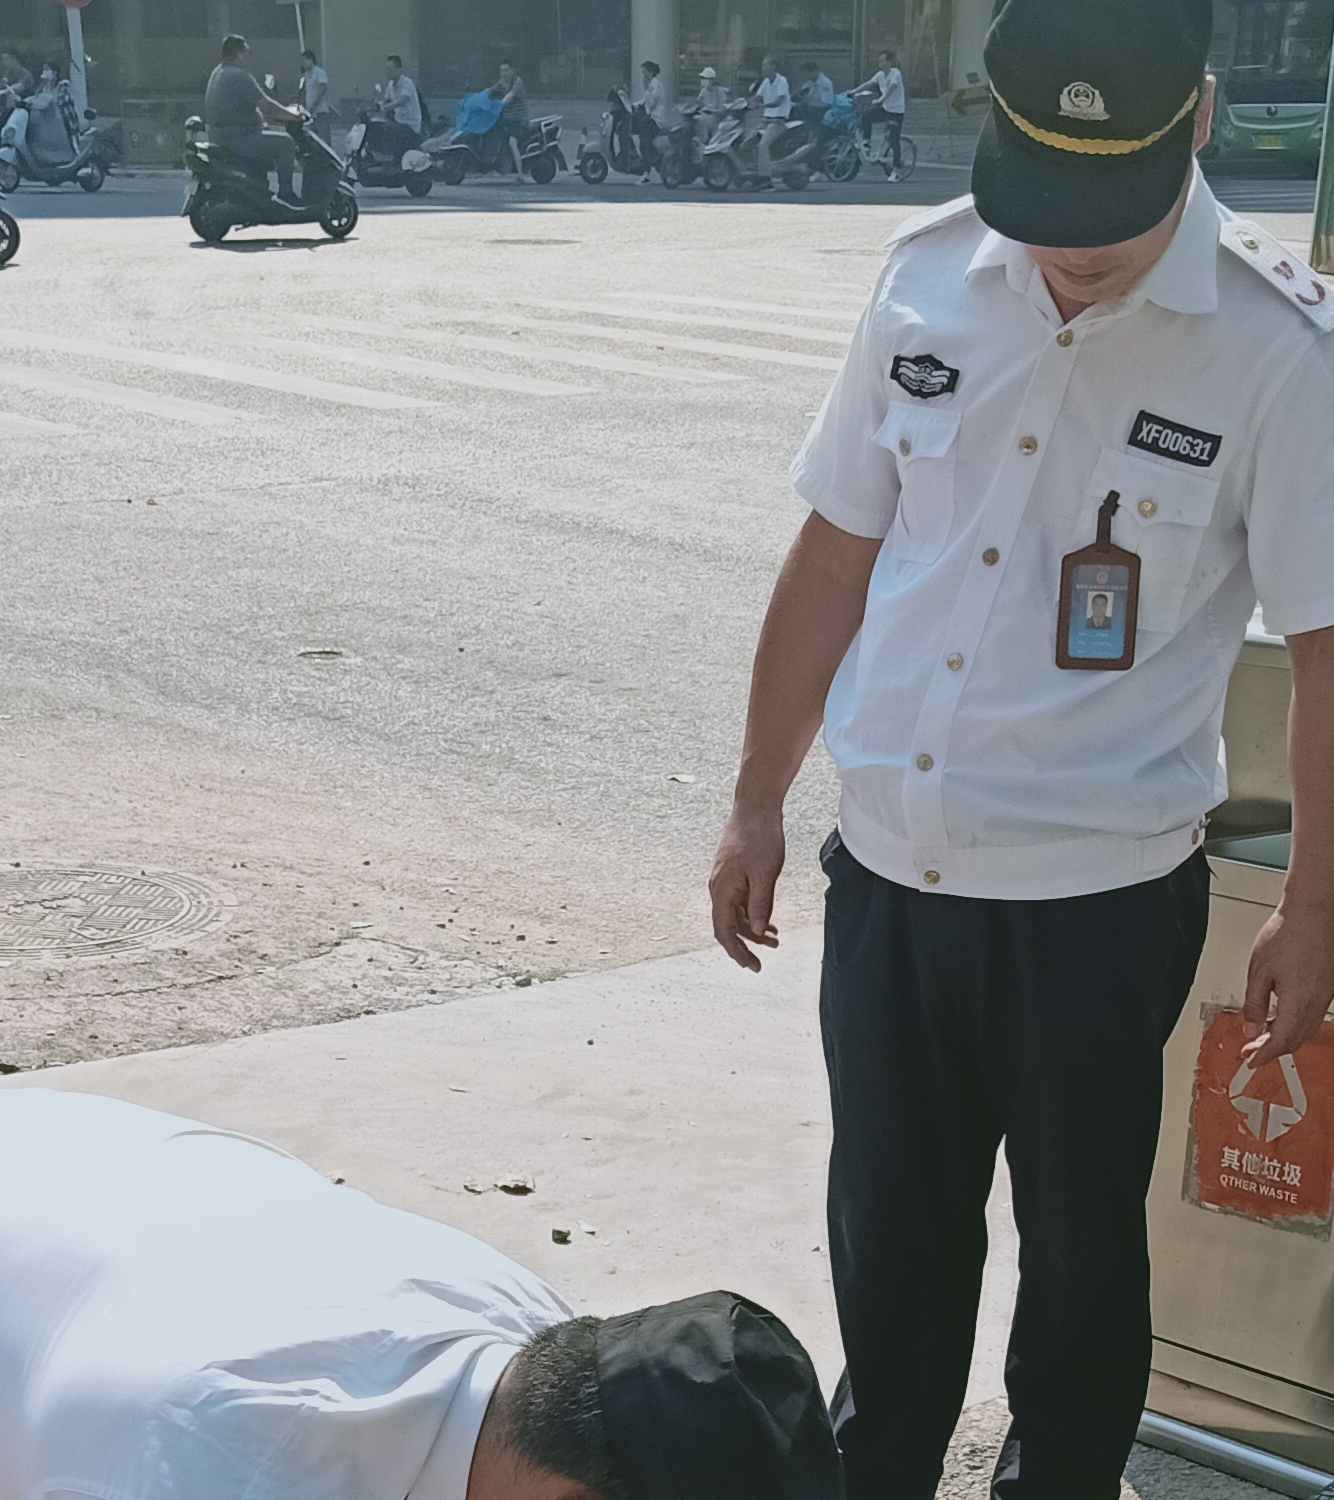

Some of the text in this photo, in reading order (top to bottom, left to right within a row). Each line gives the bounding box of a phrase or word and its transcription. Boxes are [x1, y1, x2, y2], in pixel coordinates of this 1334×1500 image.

[1136, 420, 1213, 462] XF00631
[1220, 1145, 1302, 1188] 其他垃圾
[1259, 1183, 1299, 1205] WASTE
